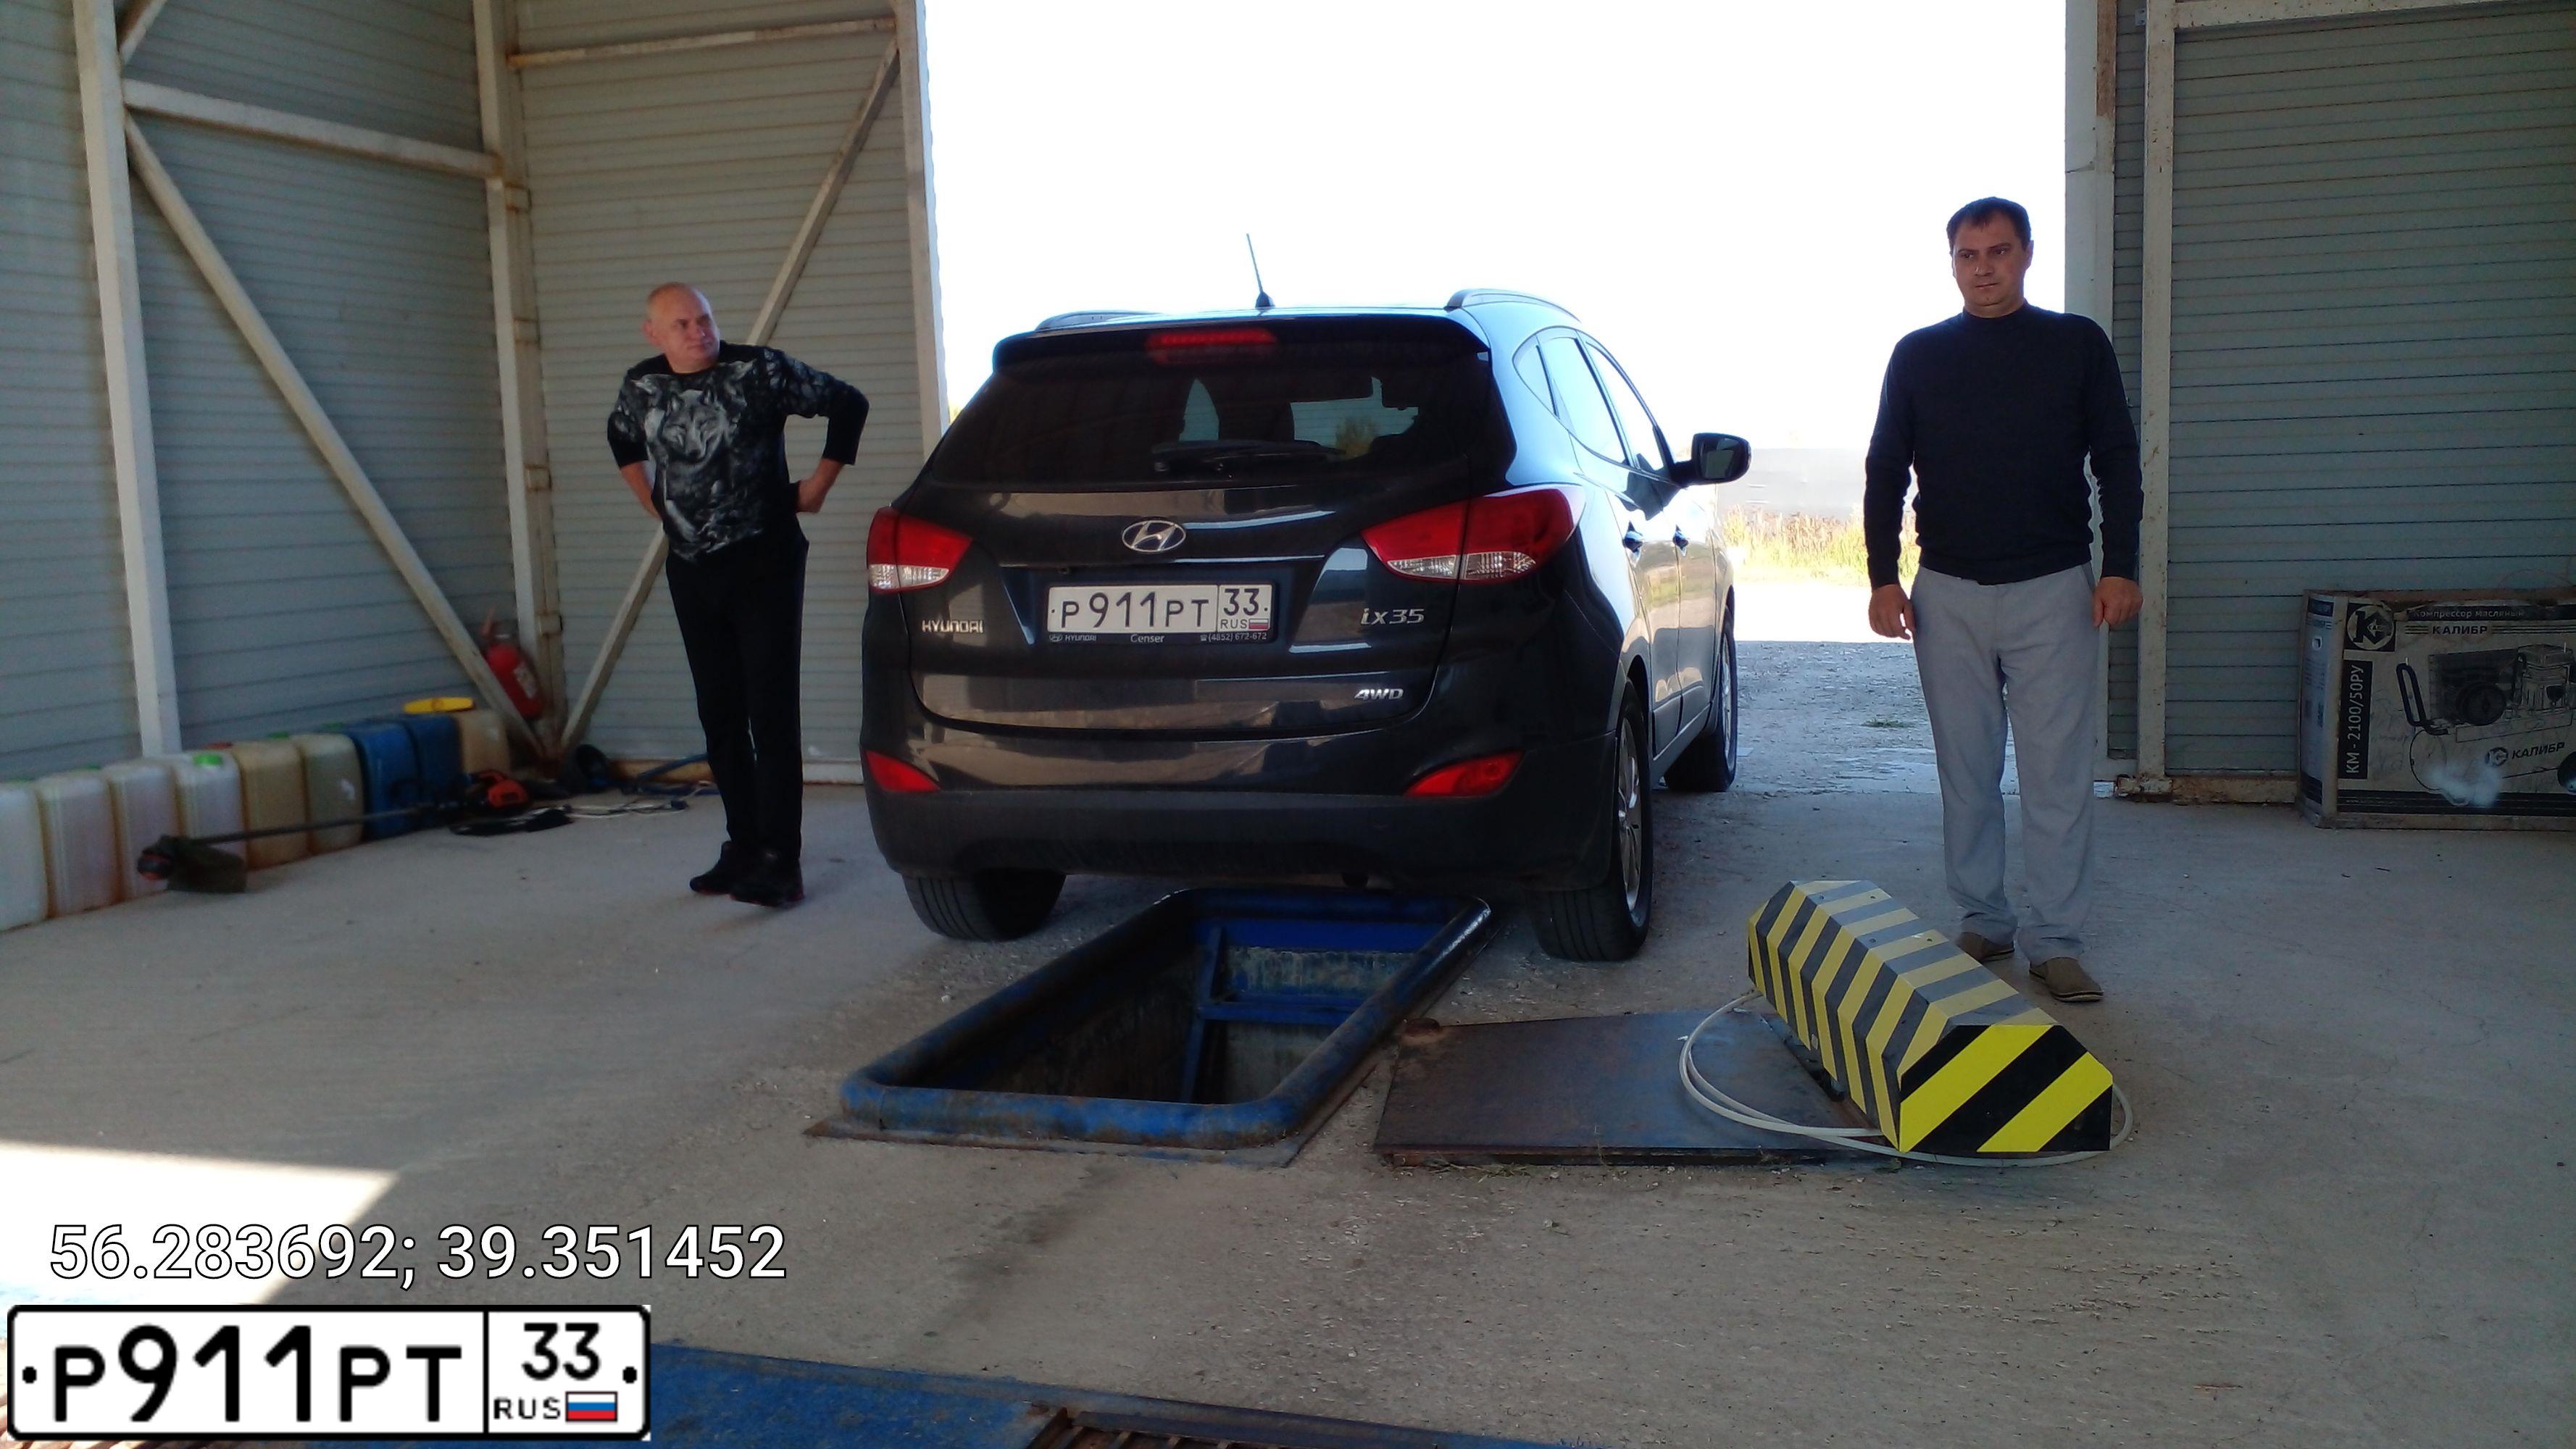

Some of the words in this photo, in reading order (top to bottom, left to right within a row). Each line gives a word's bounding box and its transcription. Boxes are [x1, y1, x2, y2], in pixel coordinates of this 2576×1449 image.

[1061, 591, 1209, 629] Р911РТ
[1223, 588, 1260, 616] 33
[1360, 607, 1425, 625] ix35
[921, 619, 984, 634] HYUNDAI
[1220, 619, 1248, 629] RUS
[2432, 625, 2488, 635] КАЛИБР
[1130, 633, 1166, 643] Censer
[1234, 632, 1267, 640] 672-672
[1354, 688, 1404, 701] 4WD
[2511, 741, 2565, 760] КАЛИБР
